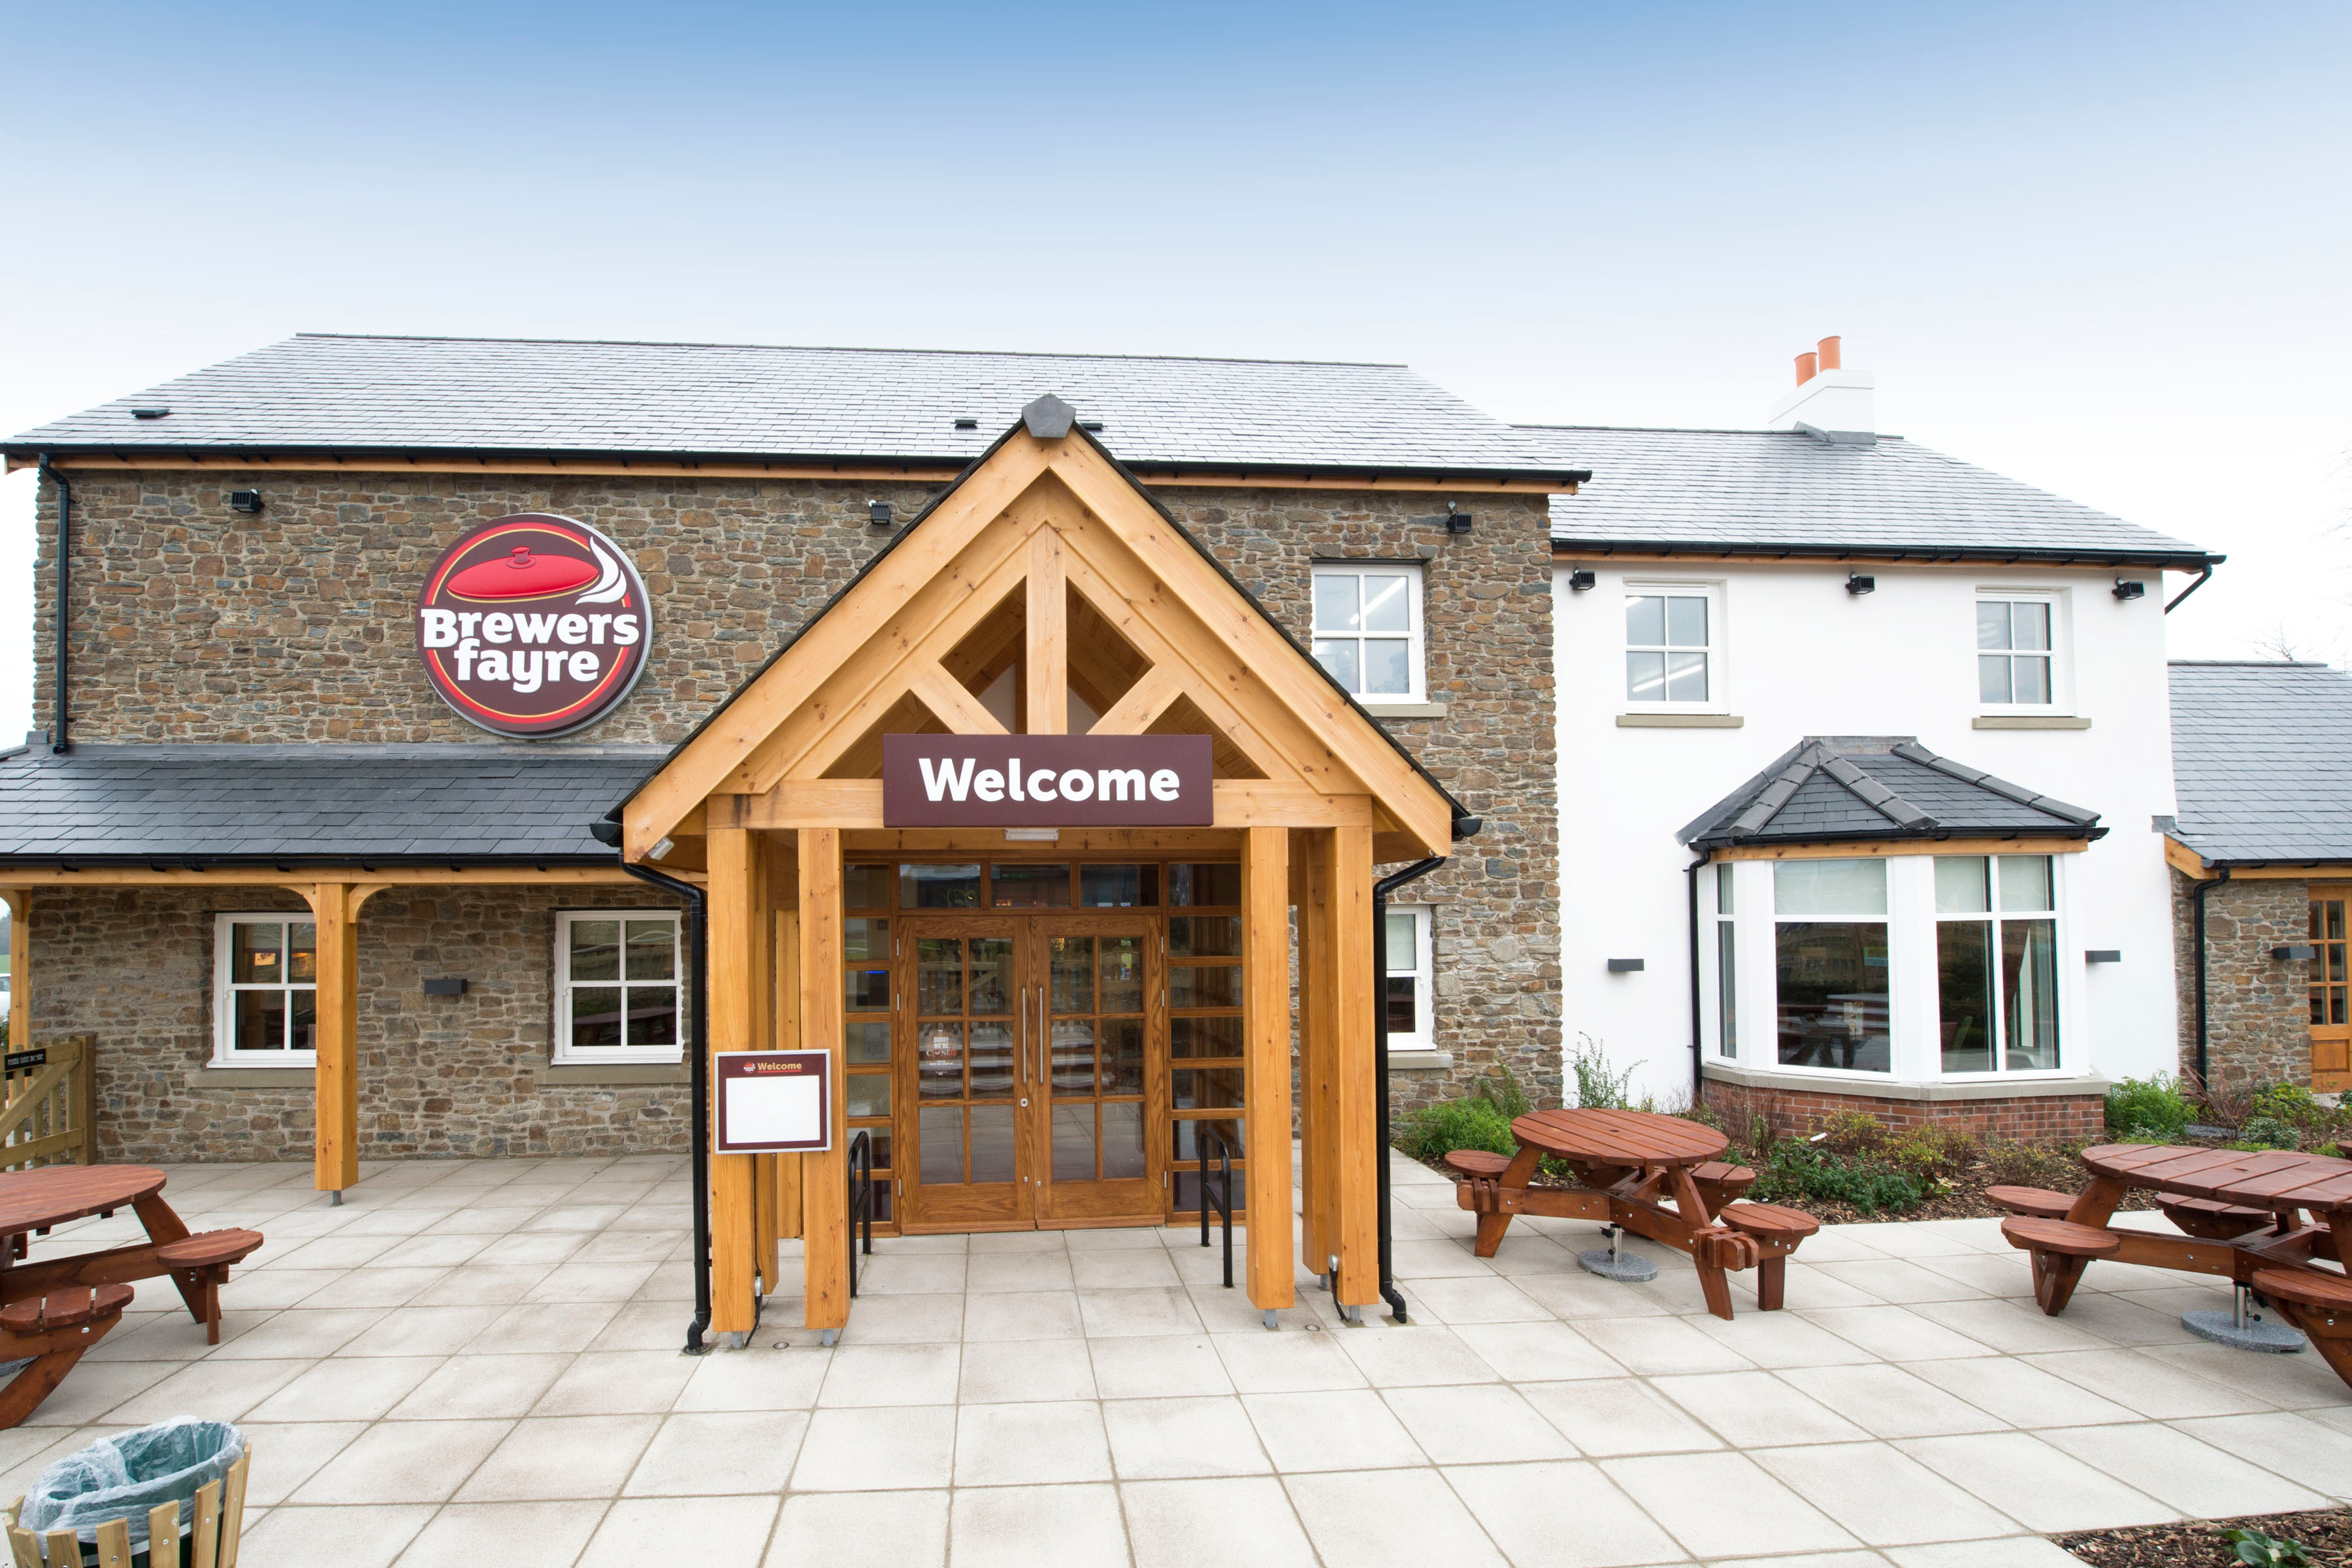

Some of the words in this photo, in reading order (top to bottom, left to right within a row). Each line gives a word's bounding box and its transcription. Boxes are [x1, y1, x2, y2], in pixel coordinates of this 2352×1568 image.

[421, 608, 640, 648] Brewers
[453, 638, 600, 693] fayre
[919, 758, 1180, 802] Welcome
[757, 1062, 802, 1071] Welcome
